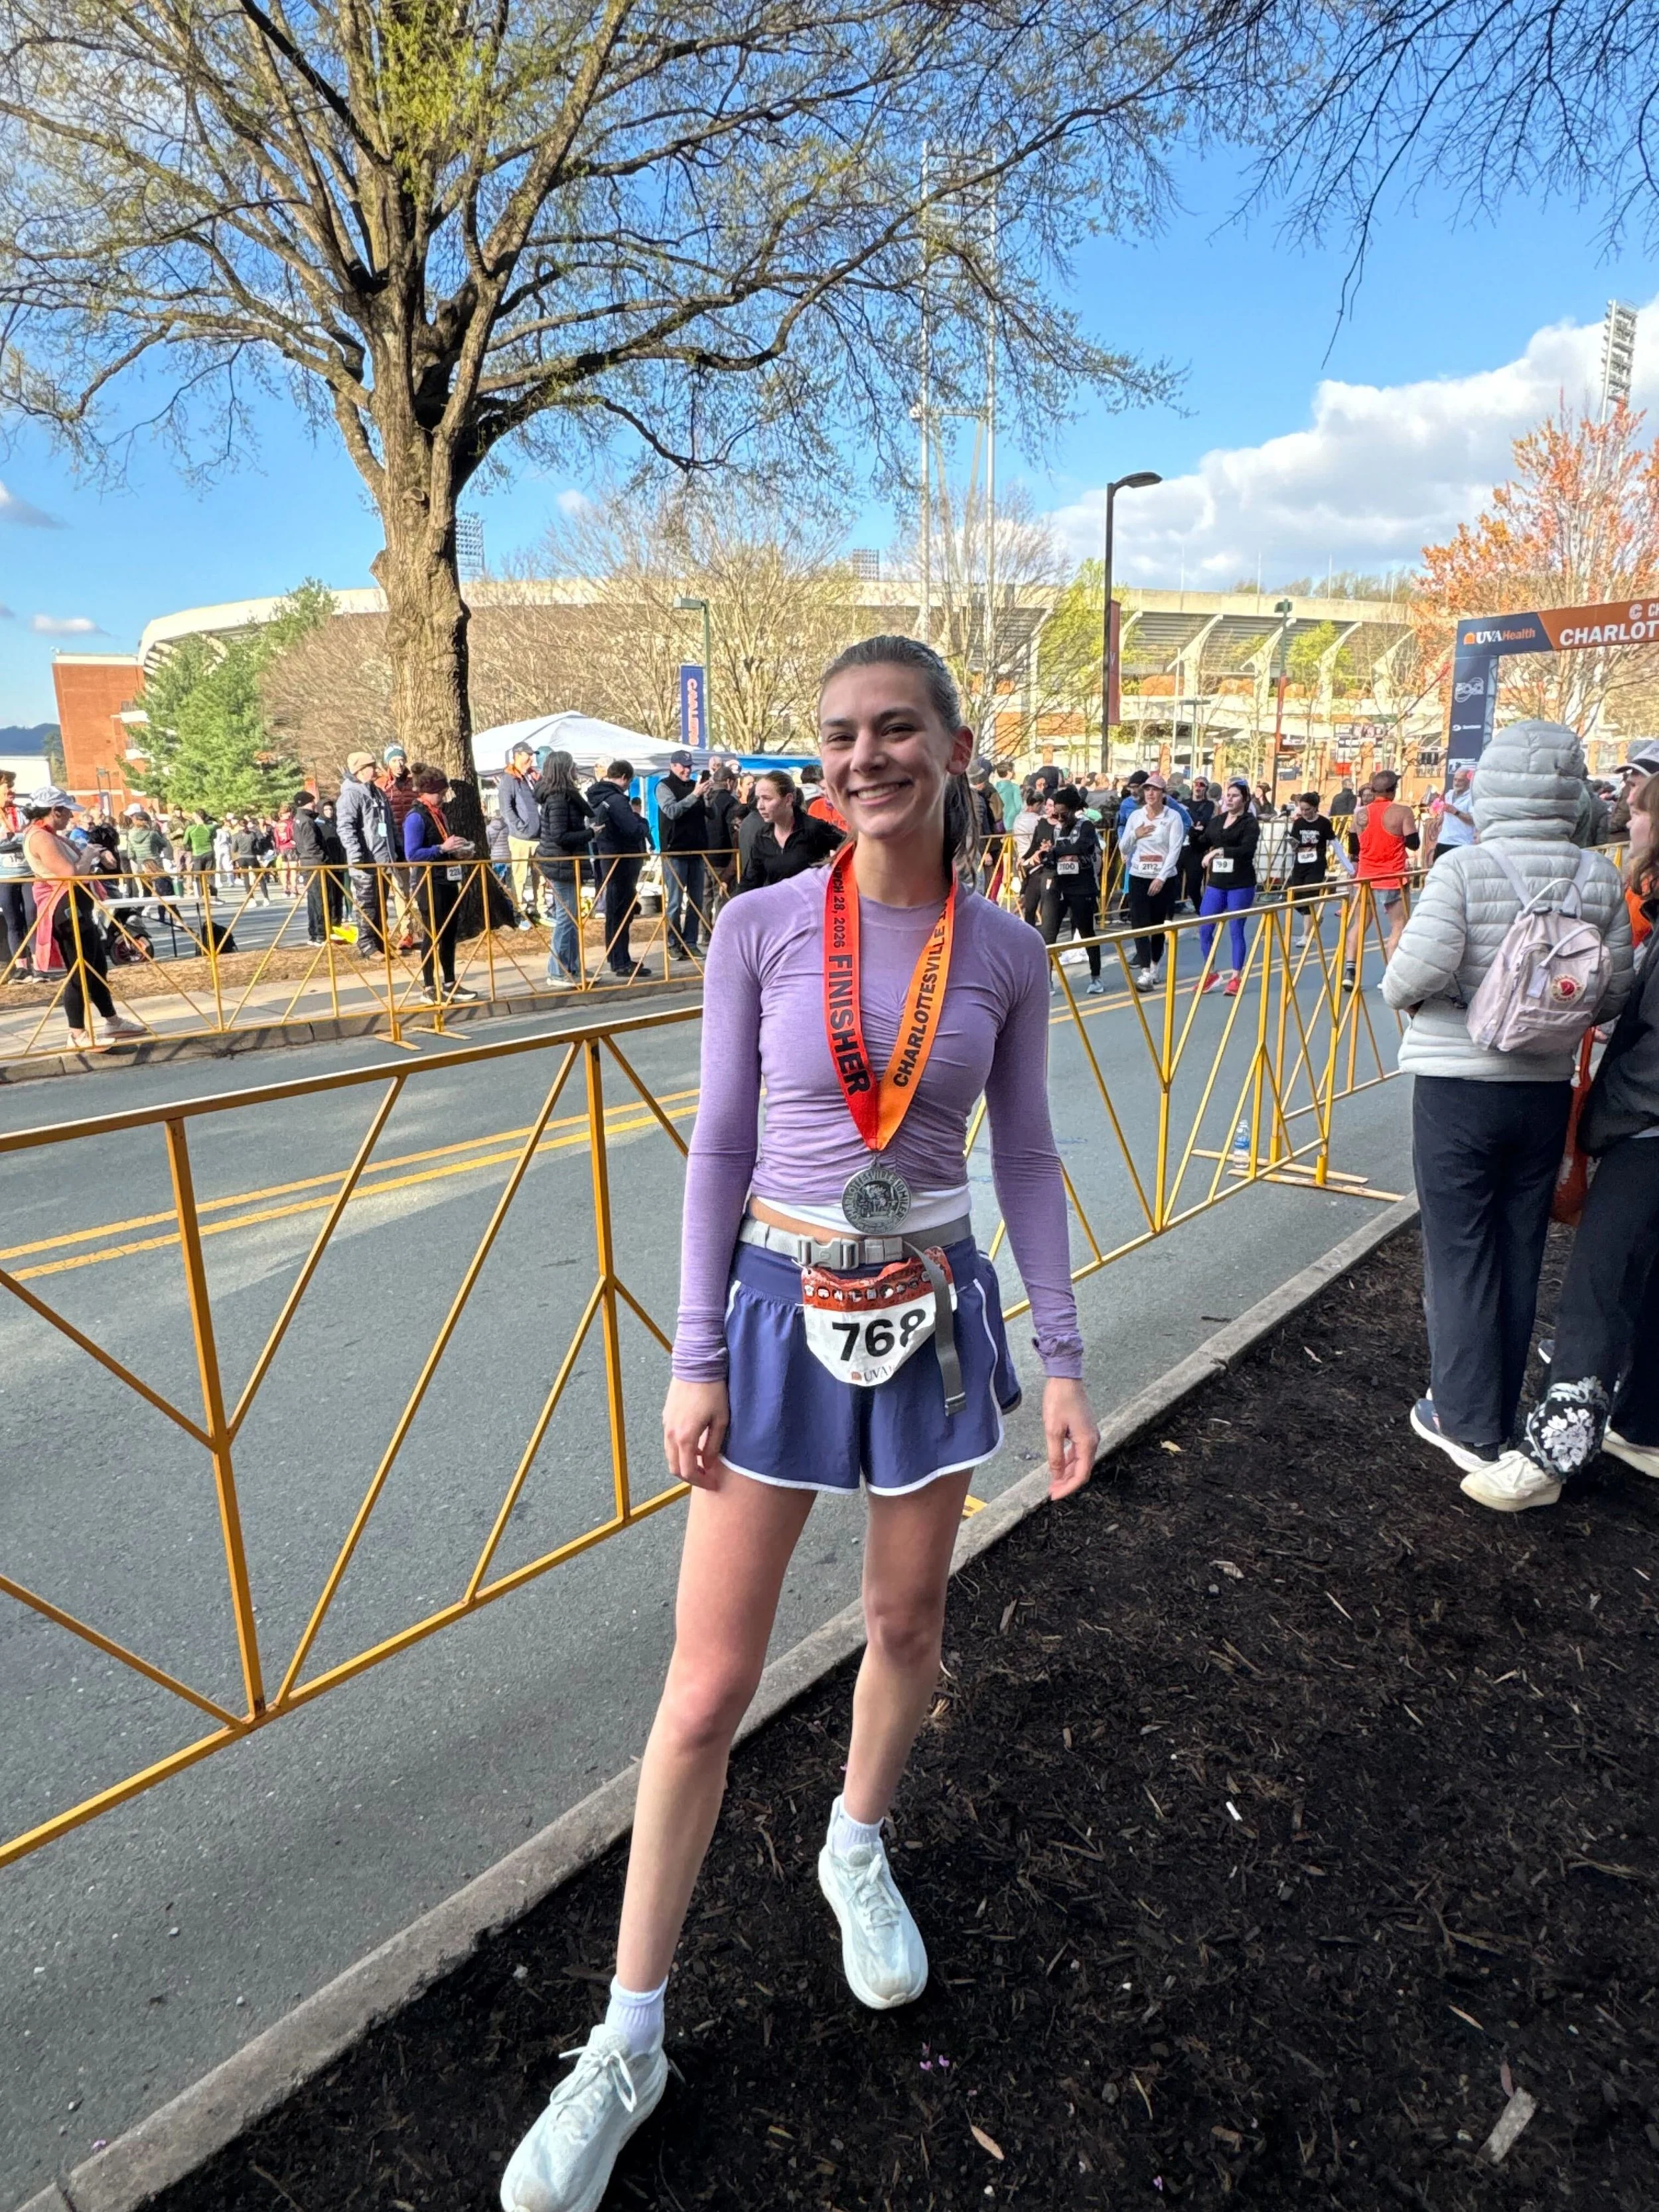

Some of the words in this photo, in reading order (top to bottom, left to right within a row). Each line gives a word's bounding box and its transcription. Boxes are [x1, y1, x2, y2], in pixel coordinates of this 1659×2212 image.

[831, 896, 845, 914] 28,
[833, 917, 845, 948] 2026
[828, 954, 871, 1096] FINISHER
[893, 926, 945, 1087] CHARLOTTESVILLE
[832, 1309, 926, 1361] 768
